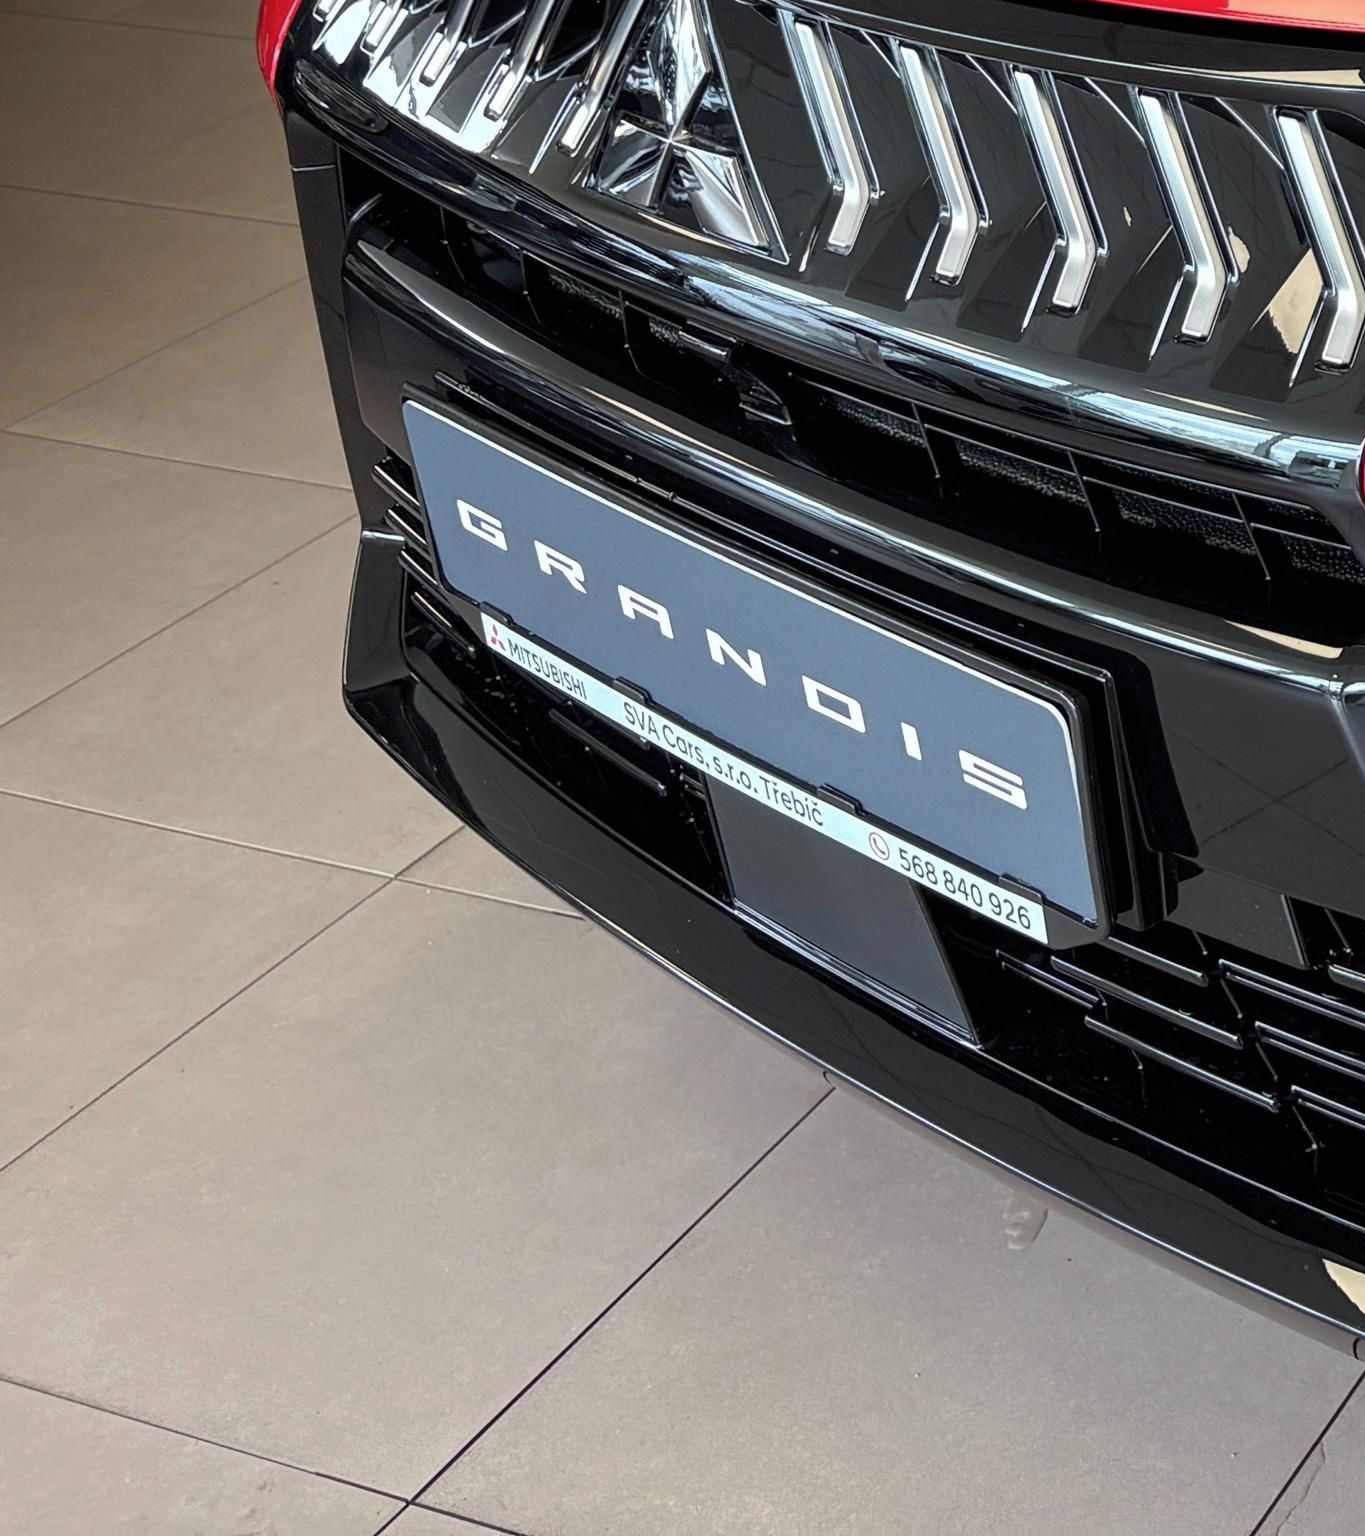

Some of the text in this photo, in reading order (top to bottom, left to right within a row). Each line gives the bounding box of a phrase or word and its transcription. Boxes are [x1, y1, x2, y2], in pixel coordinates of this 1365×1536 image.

[456, 499, 1028, 810] GRANDIS
[507, 637, 588, 700] MITSUBISHI
[623, 701, 661, 742] SVA
[662, 724, 710, 770] Cars,
[712, 755, 758, 794] s.r.o.
[898, 846, 938, 886] 568
[943, 870, 983, 908] 840
[989, 893, 1031, 930] 926
